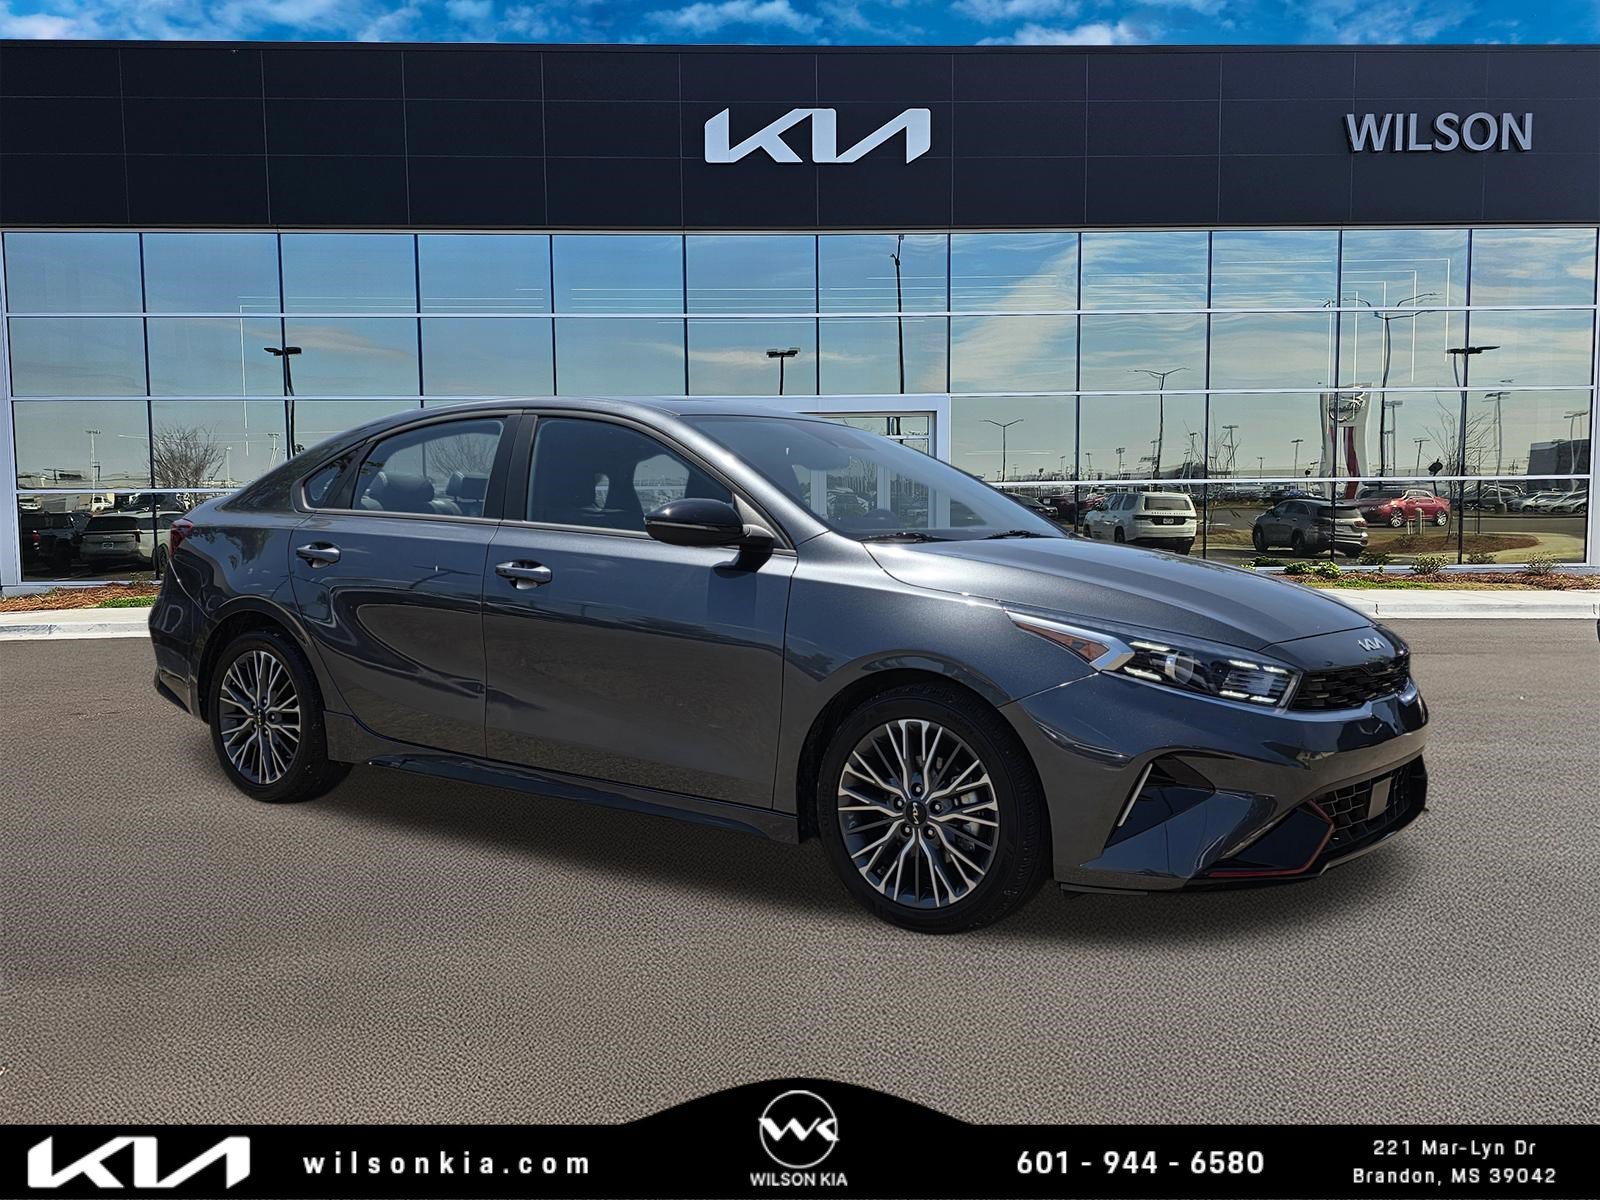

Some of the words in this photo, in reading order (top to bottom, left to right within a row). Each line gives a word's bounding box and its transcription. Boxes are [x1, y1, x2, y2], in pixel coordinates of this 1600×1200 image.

[704, 107, 931, 164] KIA
[1345, 112, 1534, 152] WILSON
[1357, 636, 1386, 651] KIA
